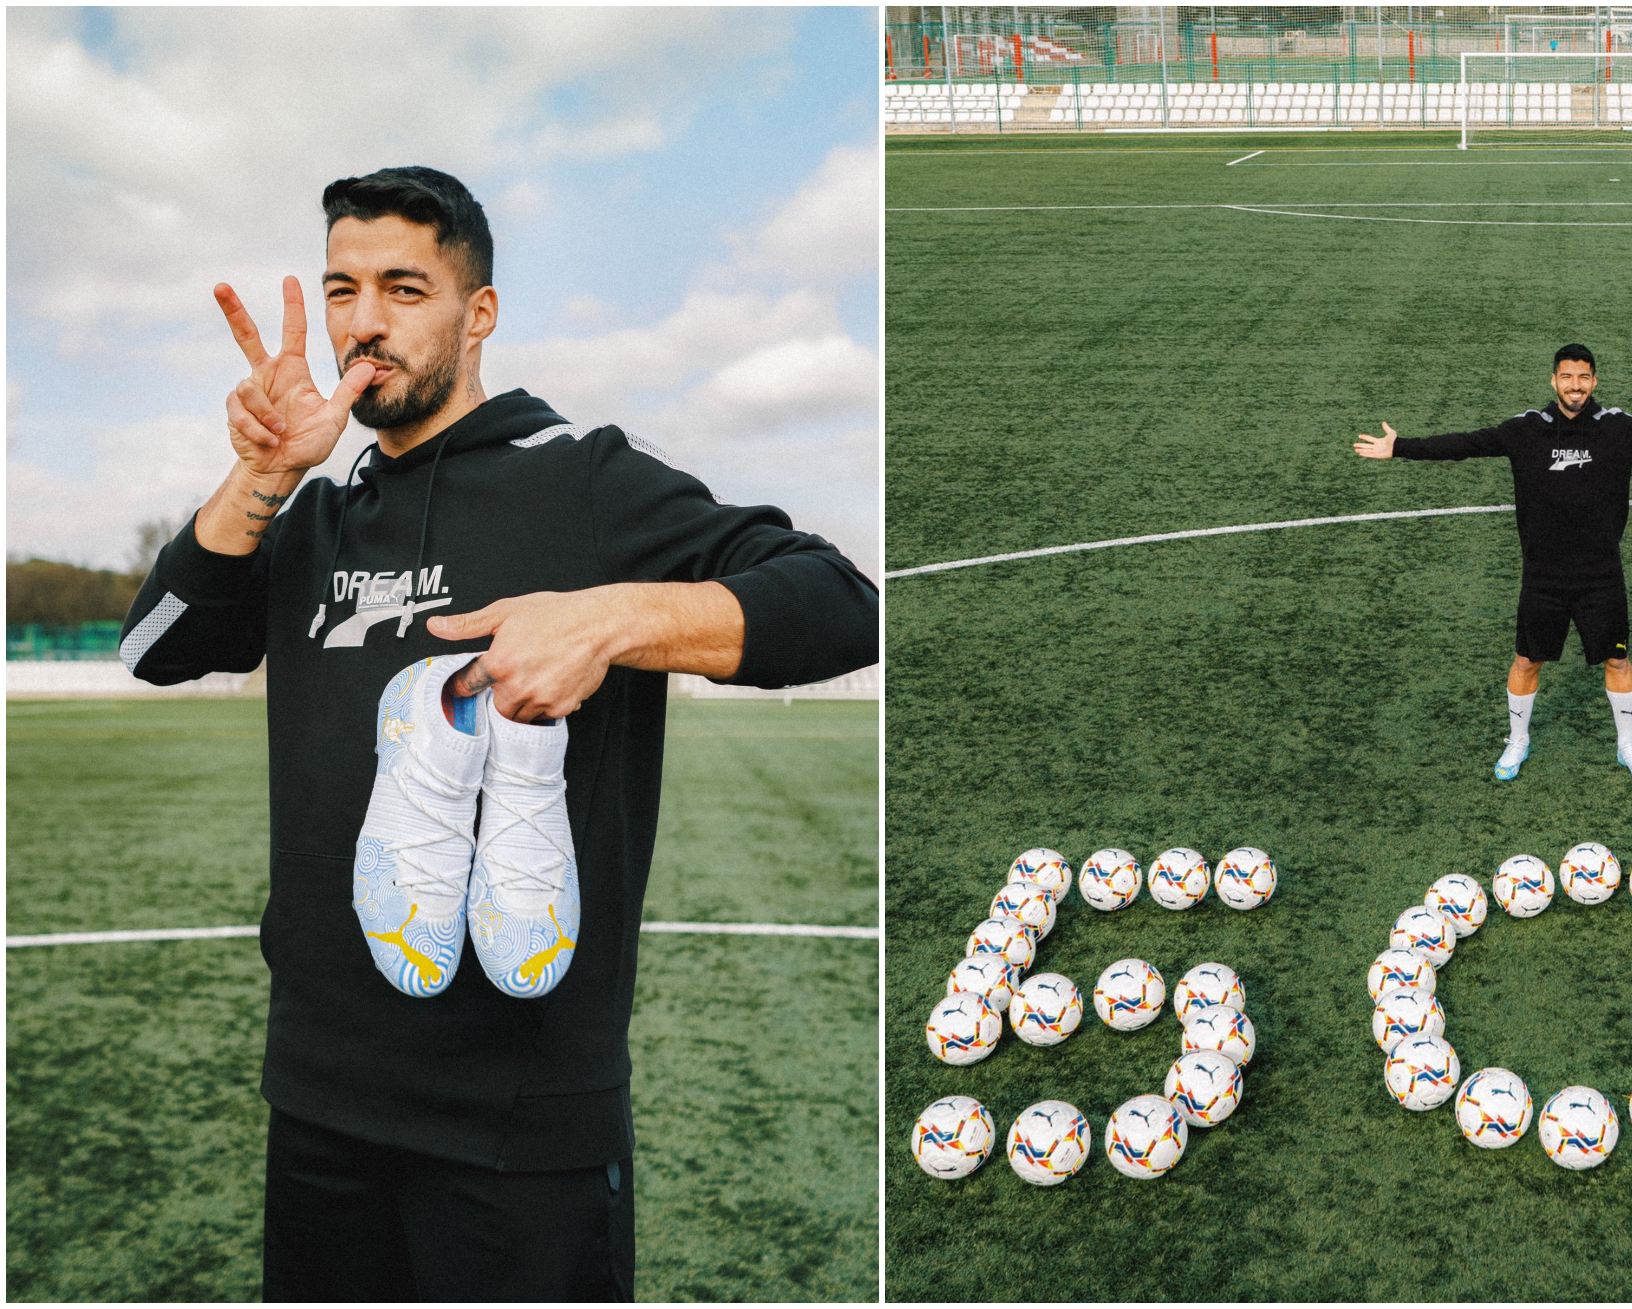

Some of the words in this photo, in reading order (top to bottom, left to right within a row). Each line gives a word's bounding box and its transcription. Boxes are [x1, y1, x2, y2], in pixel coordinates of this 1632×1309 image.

[1551, 449, 1592, 459] DREAM.
[334, 564, 449, 602] DREAM.
[360, 594, 391, 605] PUMA
